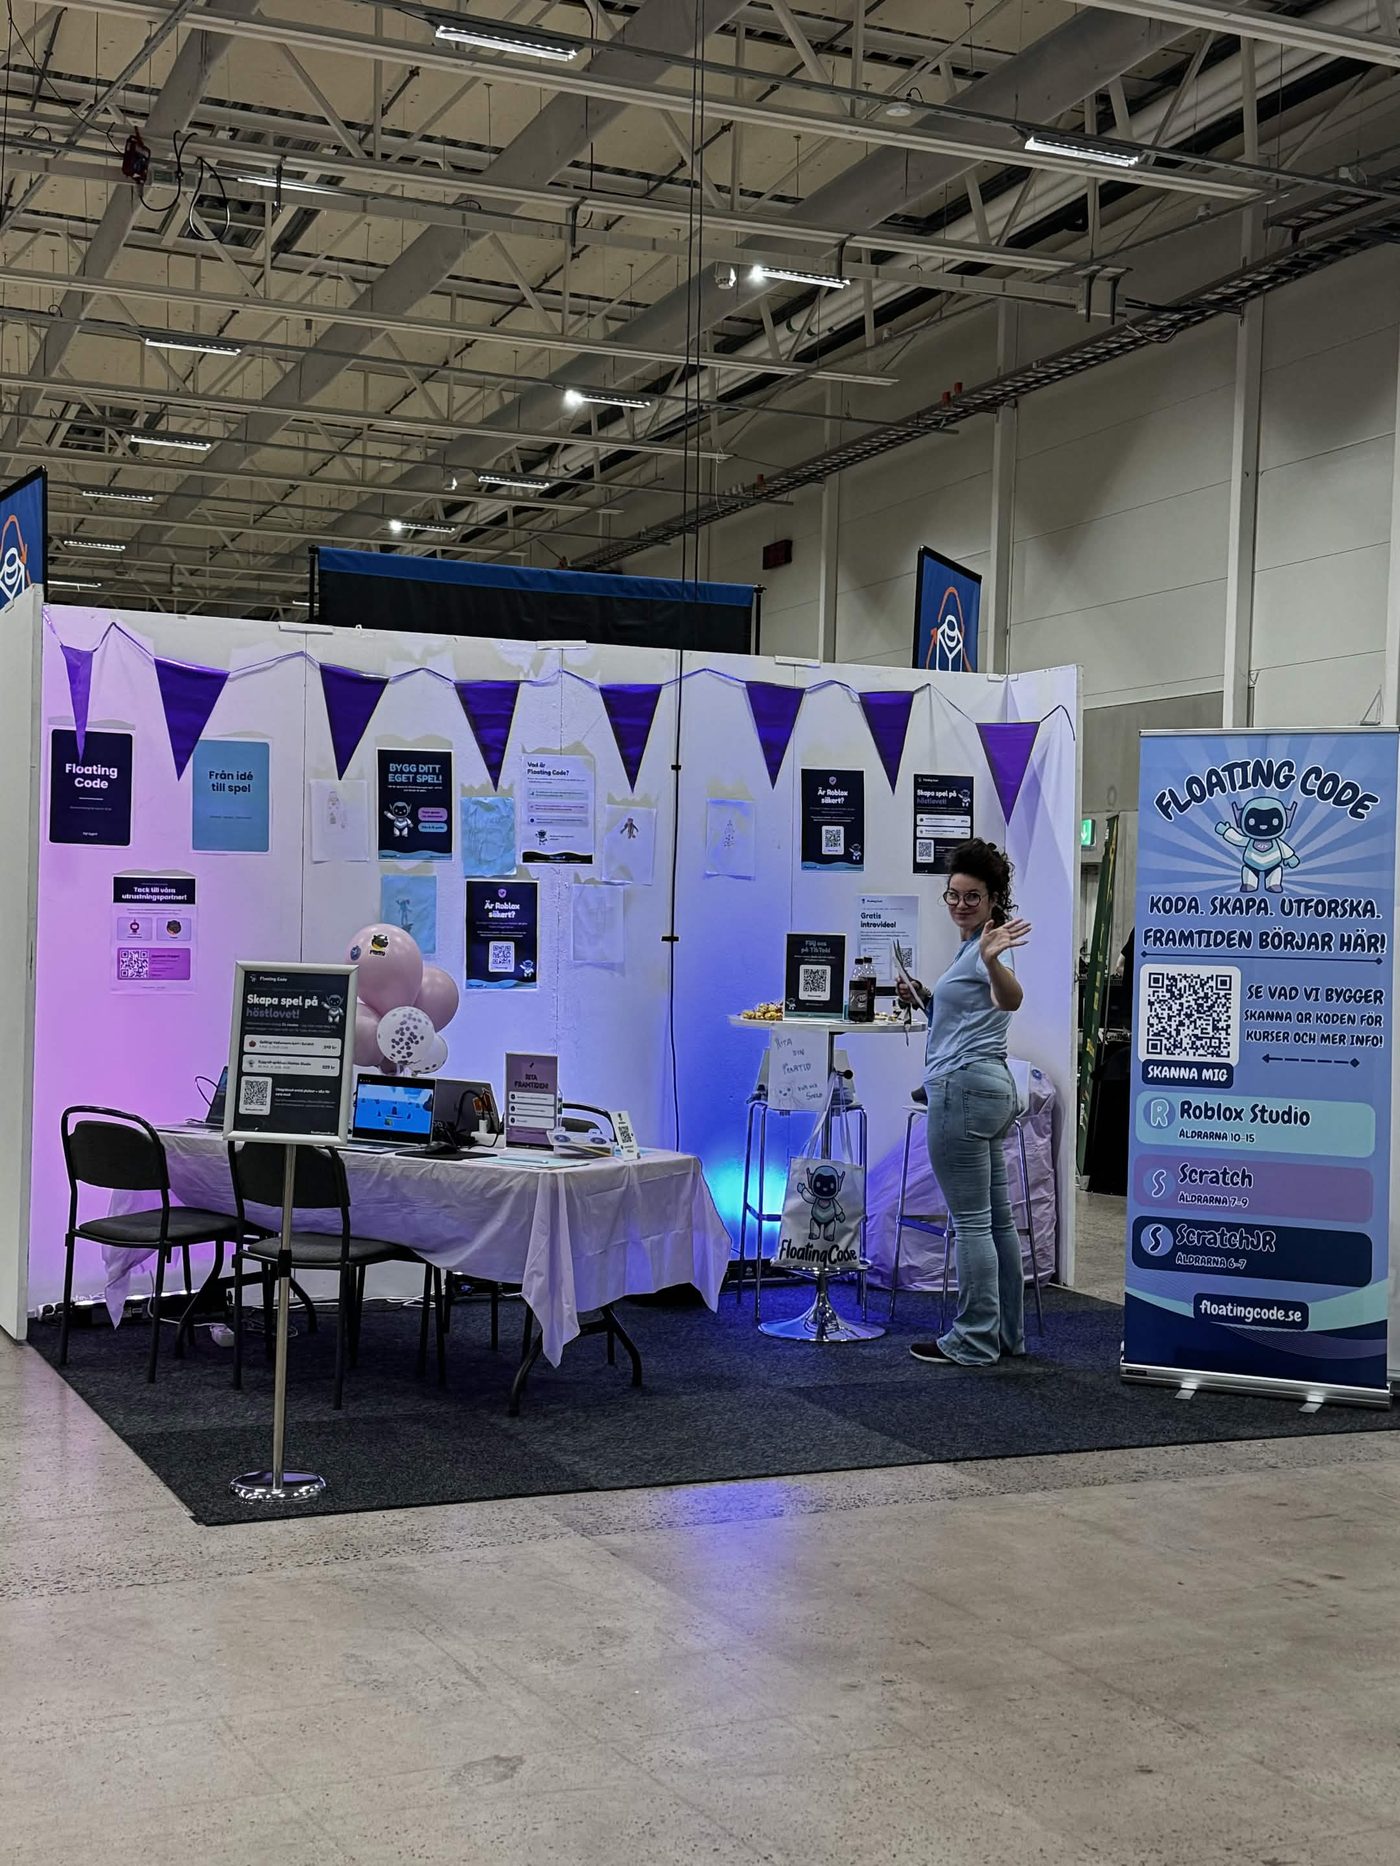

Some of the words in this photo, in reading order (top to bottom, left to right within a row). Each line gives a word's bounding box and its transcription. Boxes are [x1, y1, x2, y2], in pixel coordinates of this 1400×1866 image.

[65, 763, 118, 779] Floating
[208, 770, 234, 780] Från
[236, 770, 254, 781] idé
[389, 763, 417, 773] BYGG
[418, 764, 442, 774] DITT
[74, 777, 109, 789] Code
[388, 773, 415, 783] EGET
[416, 774, 443, 784] SPEL!
[211, 782, 226, 792] till
[227, 783, 251, 795] spel
[1154, 758, 1296, 822] FLOATING
[1299, 765, 1380, 821] CODE
[860, 912, 881, 920] Gratis
[1149, 895, 1204, 915] KODA.
[1210, 896, 1274, 917] SKAPA.
[1280, 896, 1382, 919] UTFORSKA.
[1143, 928, 1253, 949] FRAMTIDEN
[1258, 926, 1334, 951] BÖRJAR
[1339, 928, 1386, 954] HÄR!
[247, 994, 278, 1007] Skapa
[280, 995, 303, 1008] spel
[304, 995, 318, 1009] på
[1247, 984, 1264, 1000] SE
[1268, 985, 1299, 1001] VAD
[1303, 986, 1321, 1002] VI
[1325, 987, 1384, 1005] BYGGER
[1244, 1009, 1293, 1023] SKANNA
[1296, 1011, 1312, 1024] QR
[1315, 1012, 1356, 1026] KODEN
[1360, 1011, 1383, 1027] FÖR
[1245, 1029, 1290, 1044] KURSER
[1293, 1031, 1316, 1045] OCH
[1320, 1032, 1347, 1046] MER
[1350, 1034, 1384, 1049] INFO!
[1147, 1064, 1198, 1081] SKANNA
[1201, 1067, 1229, 1082] MIG
[1179, 1099, 1245, 1122] Roblox
[1249, 1103, 1311, 1127] Studio
[1178, 1162, 1254, 1189] Scratch
[1176, 1223, 1277, 1253] ScratchJR
[1200, 1299, 1302, 1322] floatingcode.se
